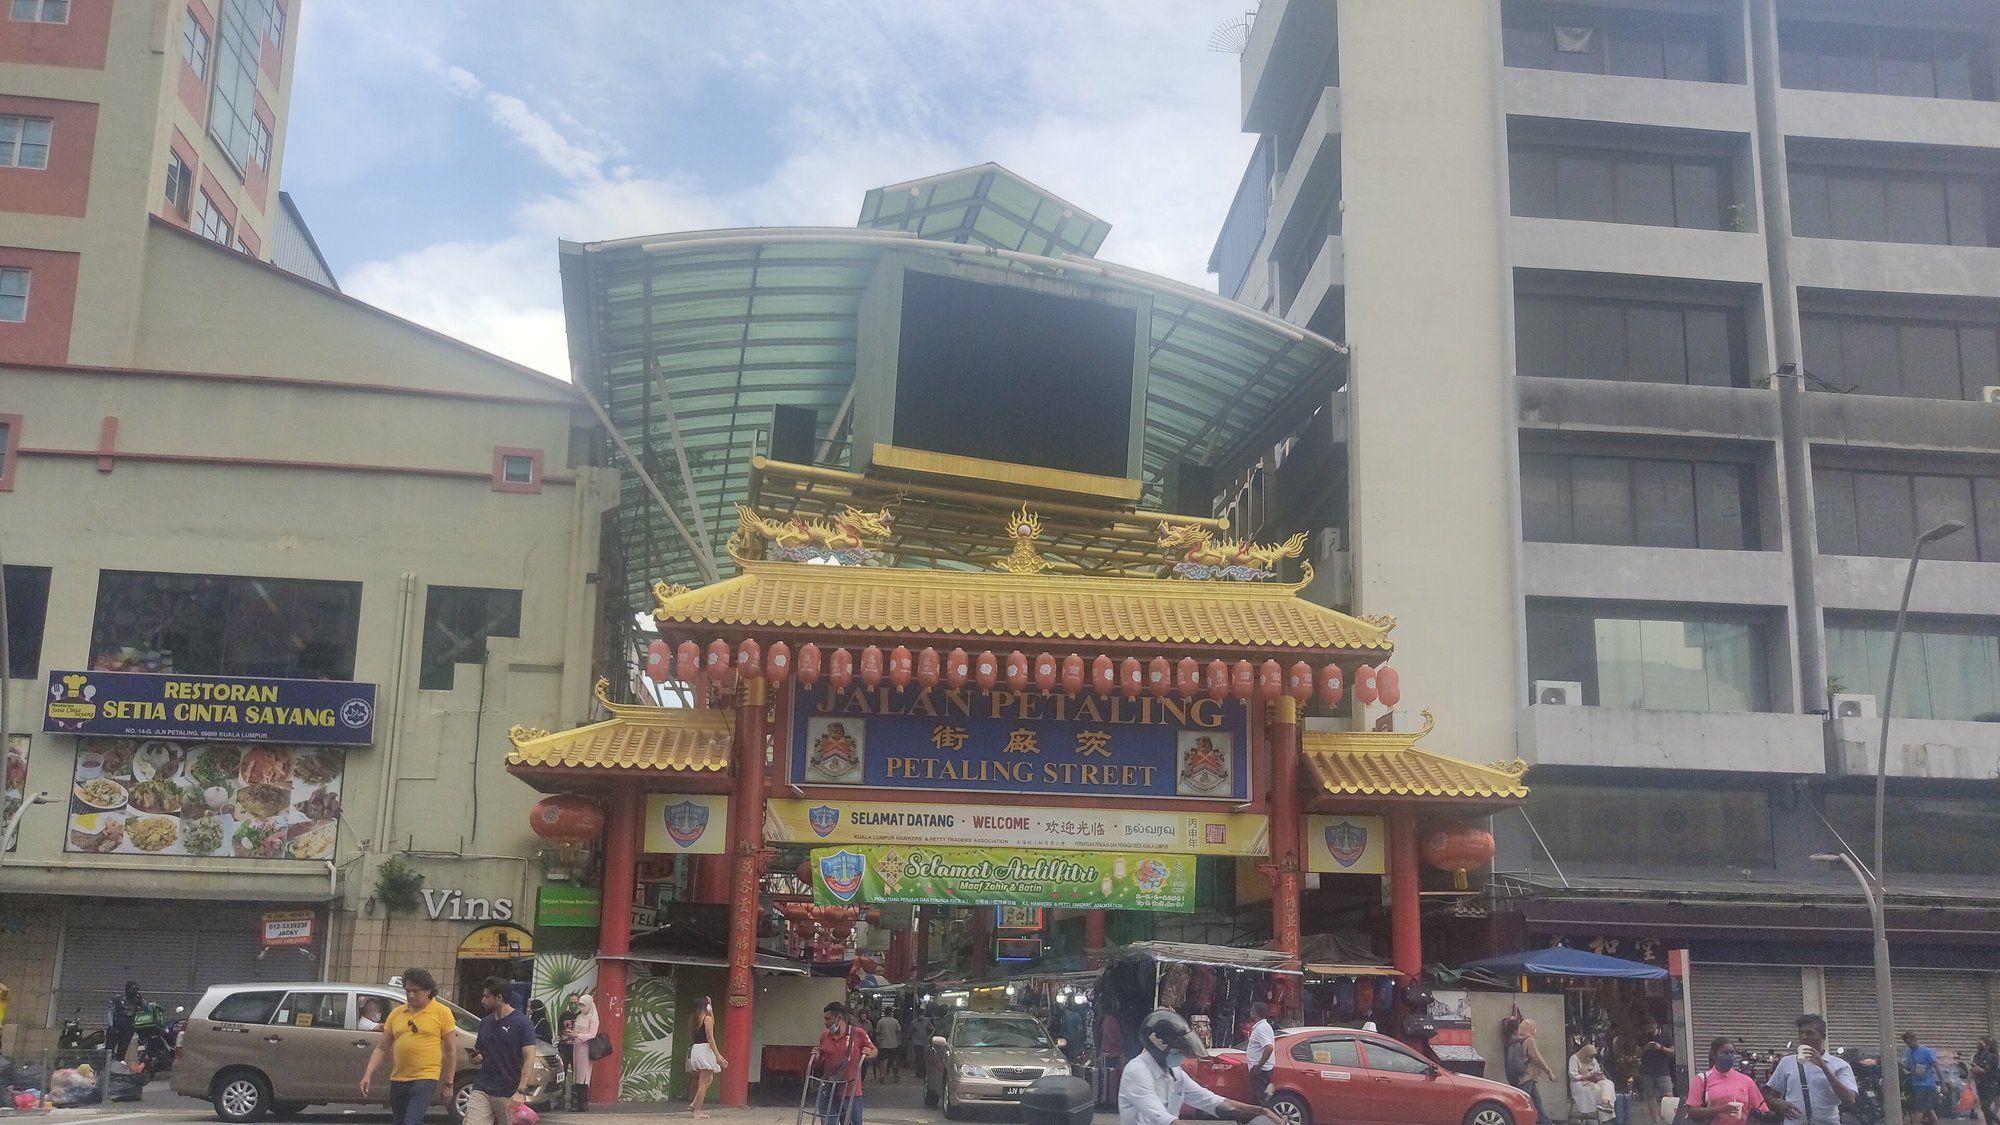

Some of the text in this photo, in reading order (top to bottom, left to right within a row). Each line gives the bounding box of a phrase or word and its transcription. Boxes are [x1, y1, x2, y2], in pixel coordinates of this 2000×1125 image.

[164, 681, 279, 702] RESTORAN
[102, 700, 336, 727] SETIA CINTA SAYANG
[816, 685, 1224, 728] JALAN PETALING
[885, 757, 1157, 787] PETALING STREET
[851, 812, 905, 827] SELAMAT
[907, 814, 954, 828] DATANG
[972, 815, 1030, 831] WELCOME
[1044, 819, 1105, 837] 欢迎光临
[1124, 824, 1175, 837] நல்வரவு
[1187, 818, 1199, 849] 丙申年
[904, 853, 1098, 883] Selamat Aidilfitri
[959, 880, 1042, 893] Maaf Zahir & Batin
[421, 888, 513, 921] Vins
